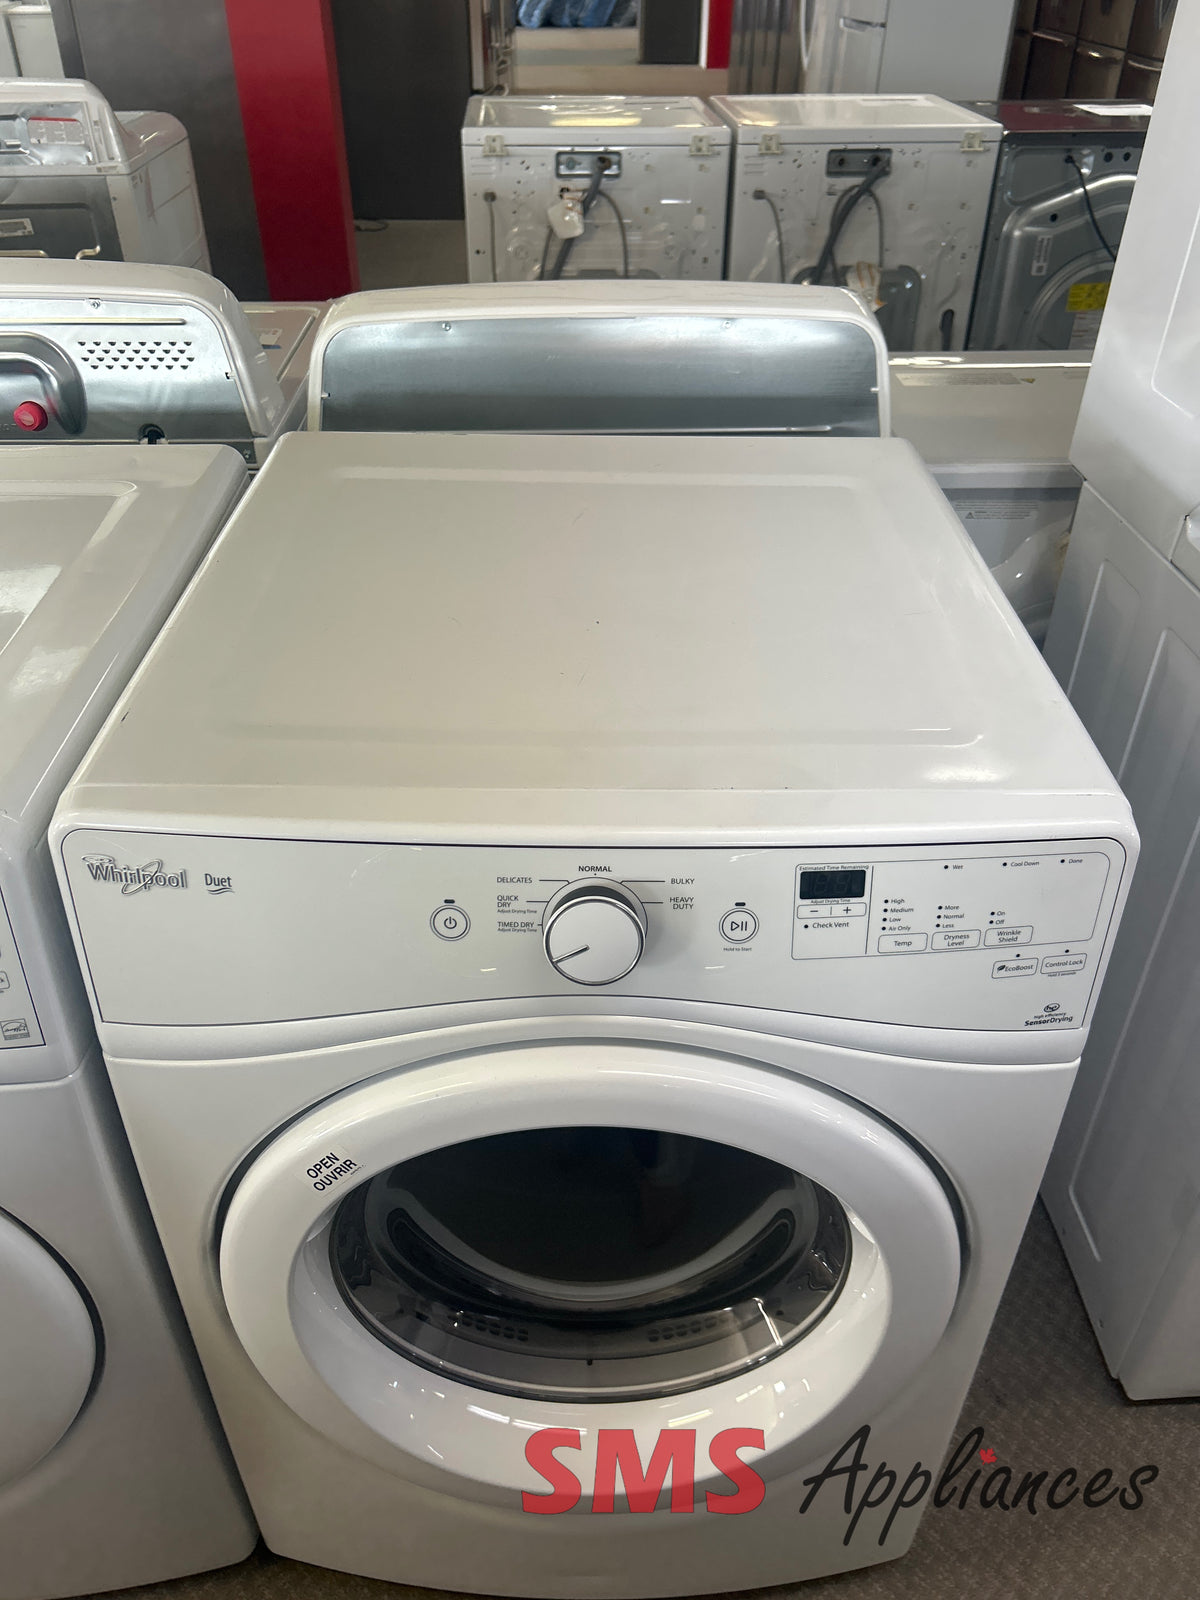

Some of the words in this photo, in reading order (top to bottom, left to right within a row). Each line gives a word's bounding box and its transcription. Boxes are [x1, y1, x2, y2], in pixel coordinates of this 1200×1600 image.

[578, 865, 612, 873] NORMAL
[85, 855, 188, 894] Whirlpool
[204, 873, 232, 888] Duet
[496, 876, 533, 884] DELICATES
[943, 912, 965, 920] Normal
[996, 909, 1006, 917] On
[995, 918, 1005, 926] Off
[943, 933, 970, 942] Dryness
[893, 940, 913, 948] Temp
[947, 940, 965, 948] Level
[1004, 964, 1034, 973] EcoBoost
[1024, 1016, 1073, 1027] SensorDrying
[306, 1152, 340, 1179] OPEN
[313, 1159, 357, 1191] OUVRIR
